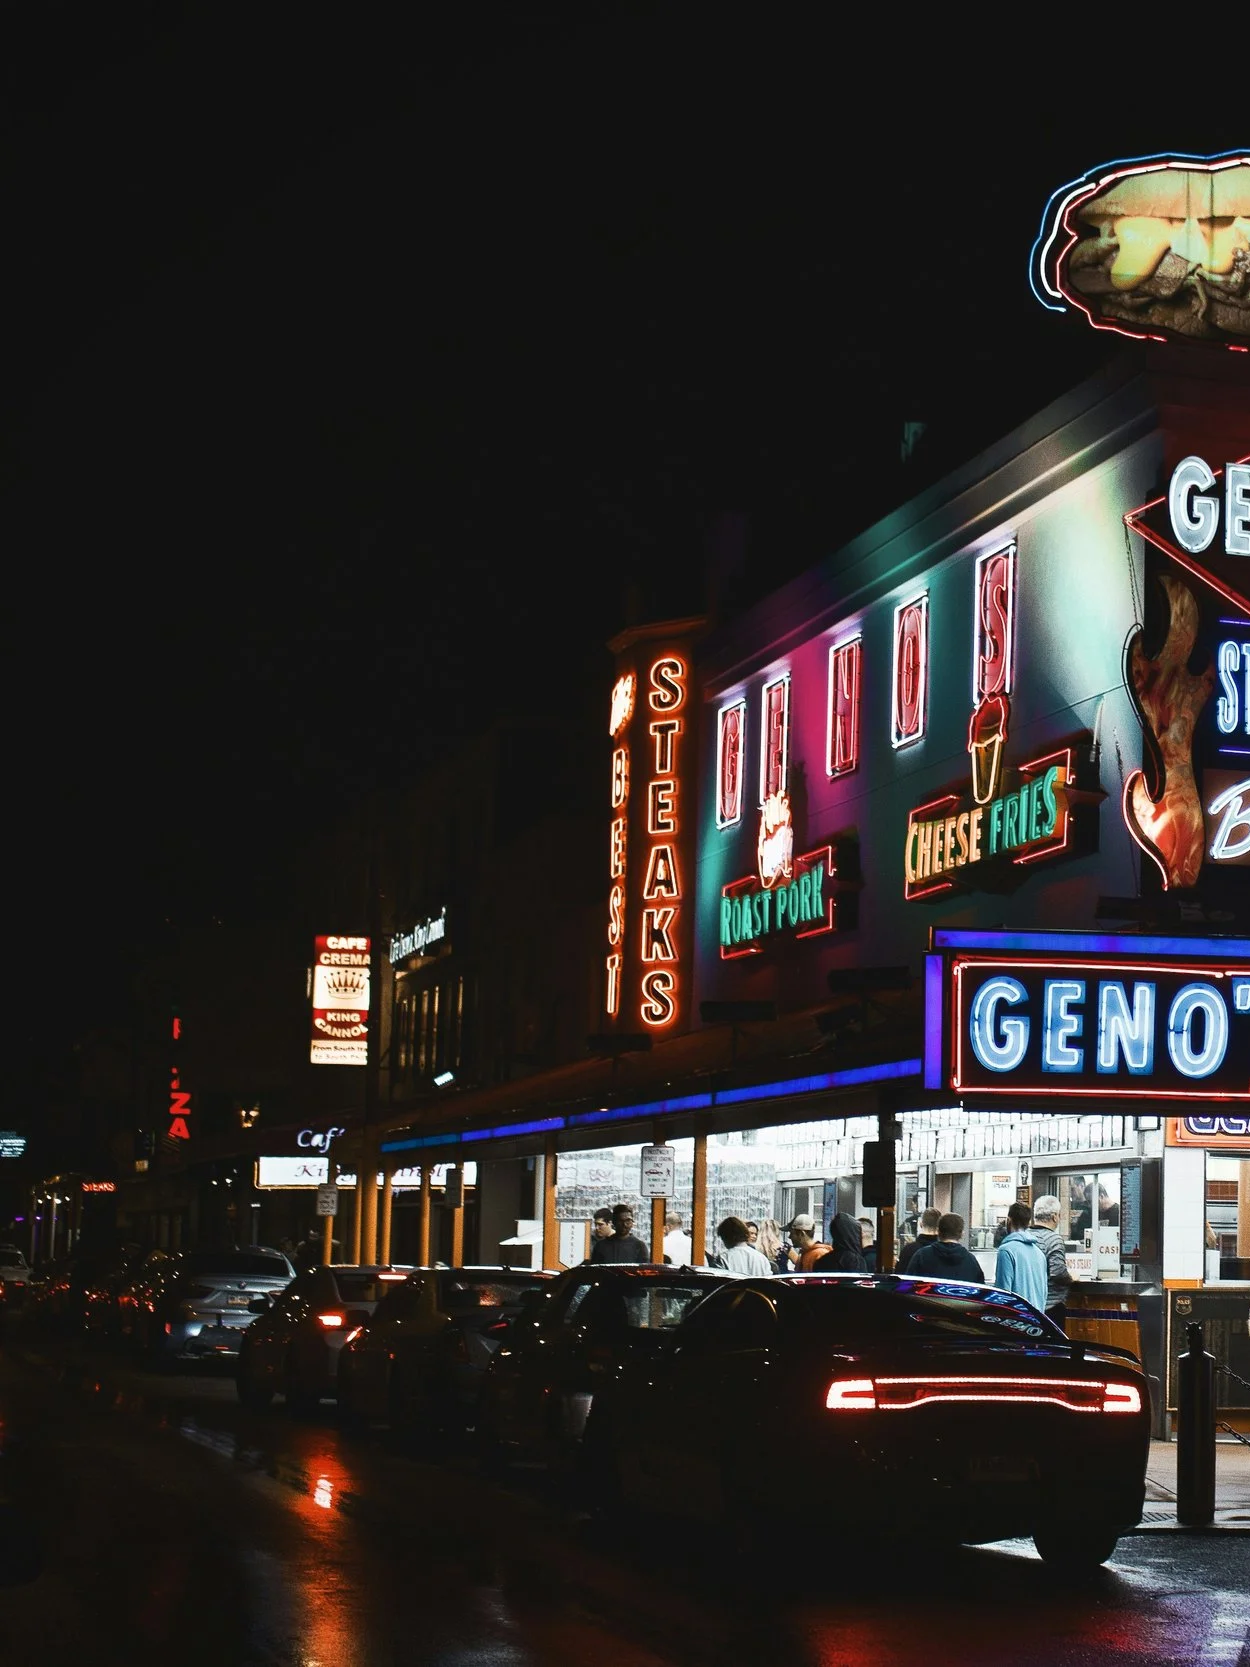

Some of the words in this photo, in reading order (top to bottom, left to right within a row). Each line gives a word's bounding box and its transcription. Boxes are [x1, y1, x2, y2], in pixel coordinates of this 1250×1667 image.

[641, 657, 684, 1026] STEAKS
[905, 807, 983, 883] CHEESE
[989, 766, 1059, 855] FRIES
[606, 748, 630, 1015] BEST
[720, 887, 771, 946] ROAST
[775, 860, 824, 930] PORK
[319, 952, 371, 966] CREMA
[326, 936, 368, 951] CAFE
[326, 1012, 361, 1023] KING
